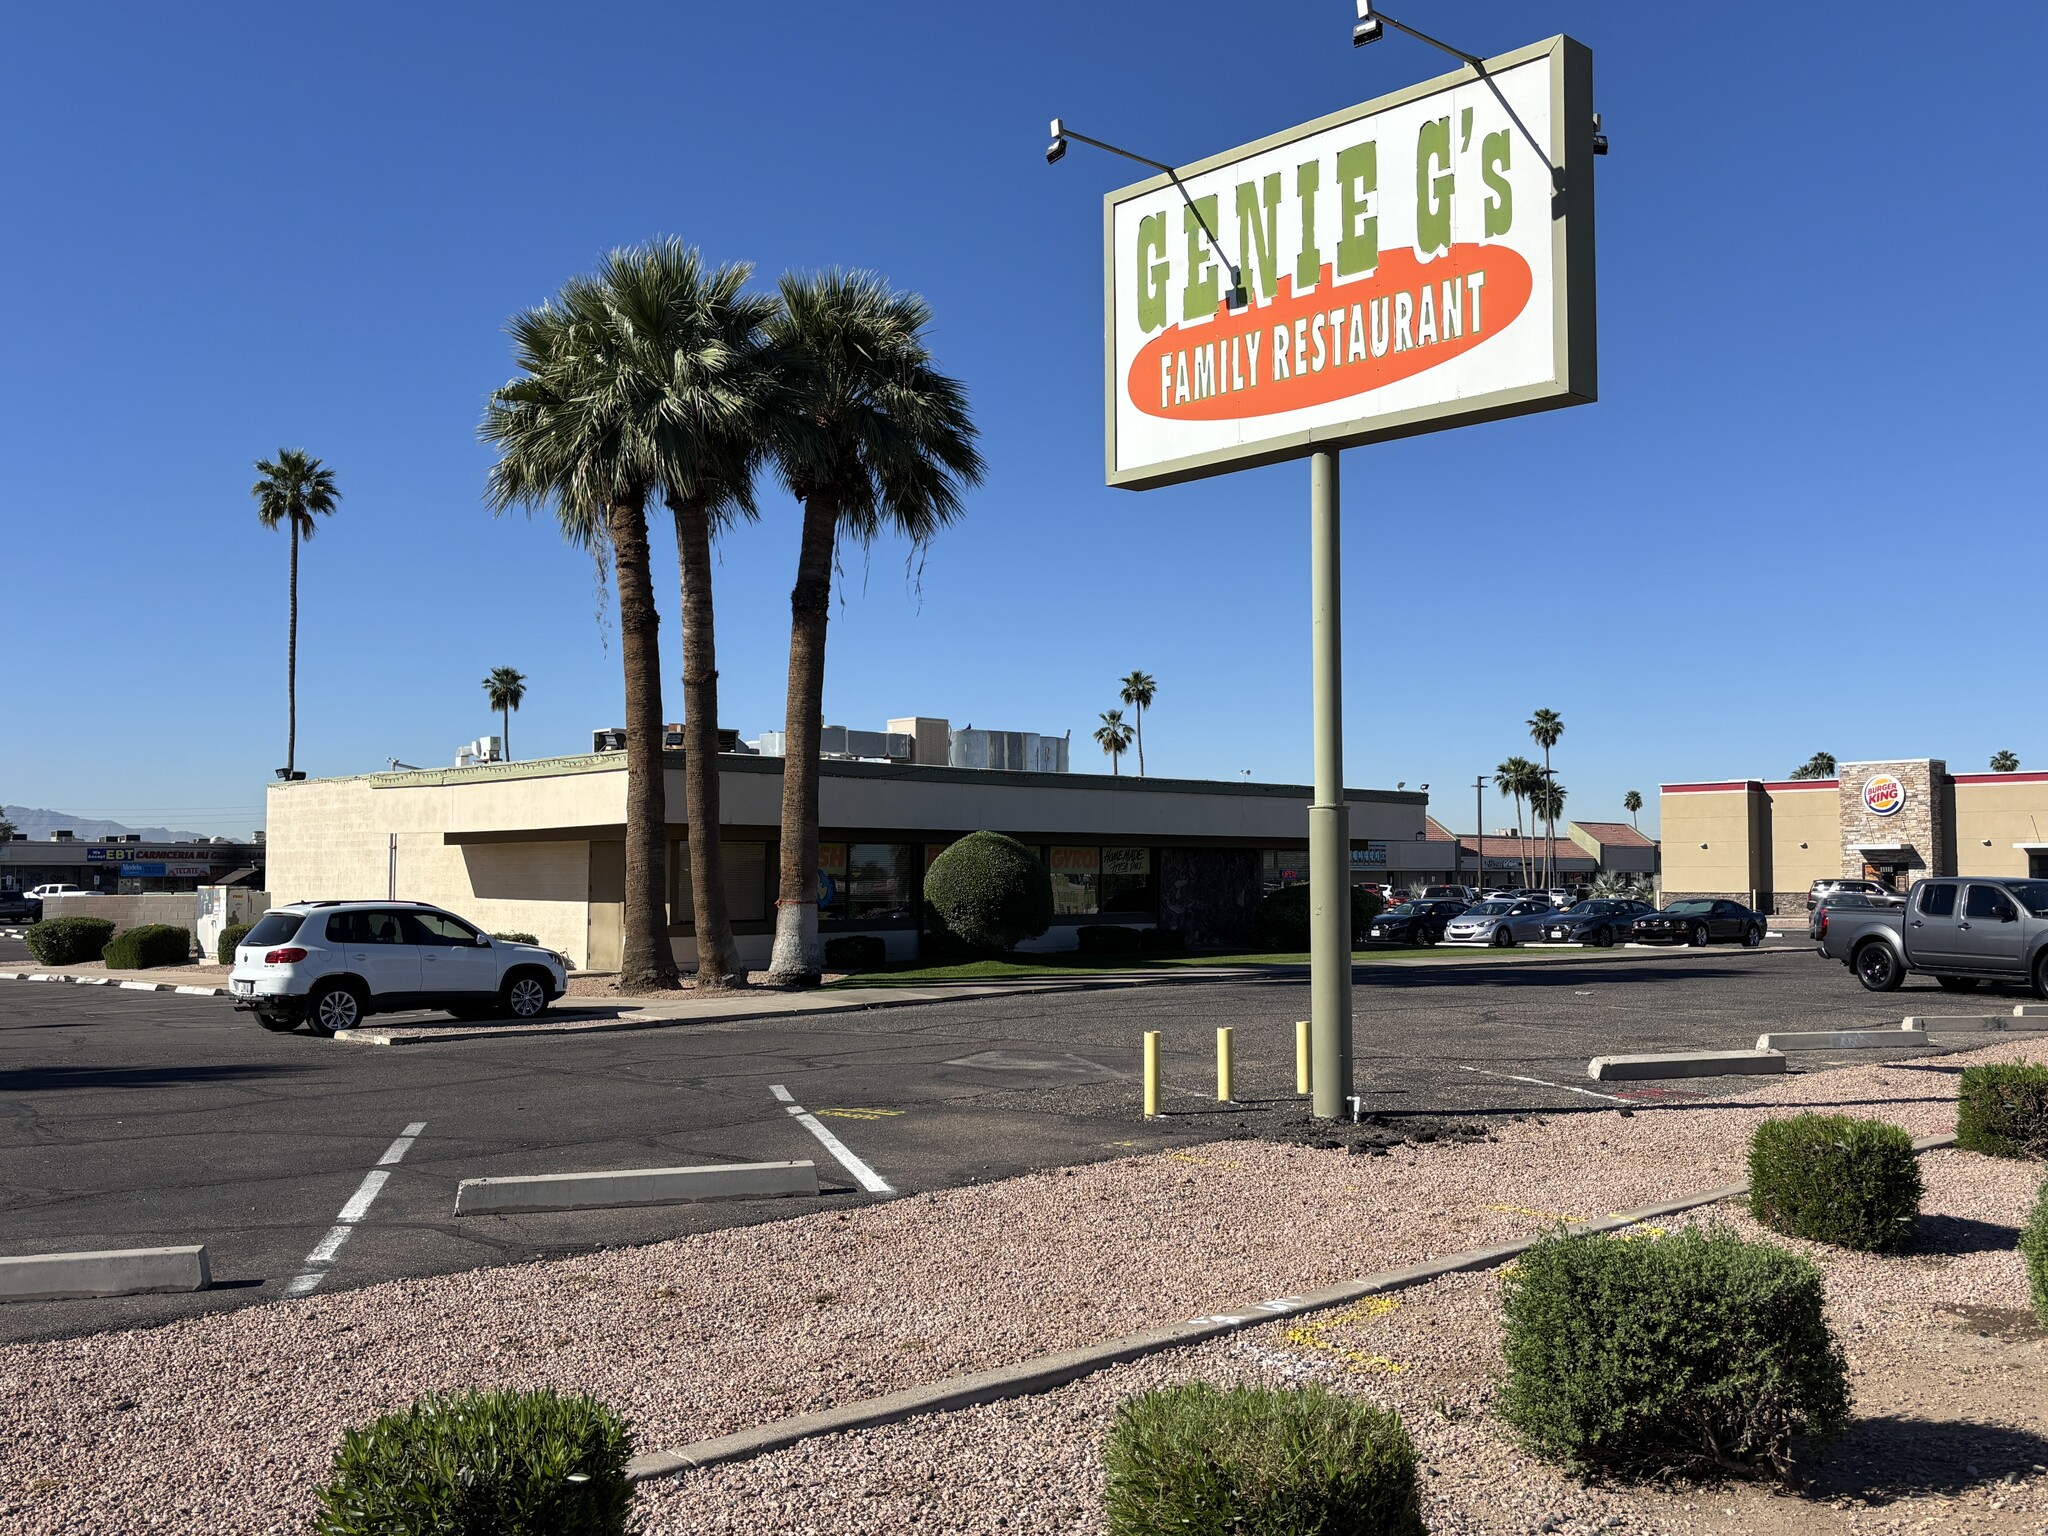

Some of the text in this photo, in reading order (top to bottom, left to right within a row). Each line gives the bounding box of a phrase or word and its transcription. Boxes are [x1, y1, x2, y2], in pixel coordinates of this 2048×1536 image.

[1136, 139, 1378, 334] GENIE
[1159, 270, 1486, 409] FAMILY RESTAURANT
[1867, 782, 1898, 796] BURGER
[1868, 789, 1898, 805] KING
[105, 849, 134, 860] EBT
[175, 867, 200, 875] TECATE
